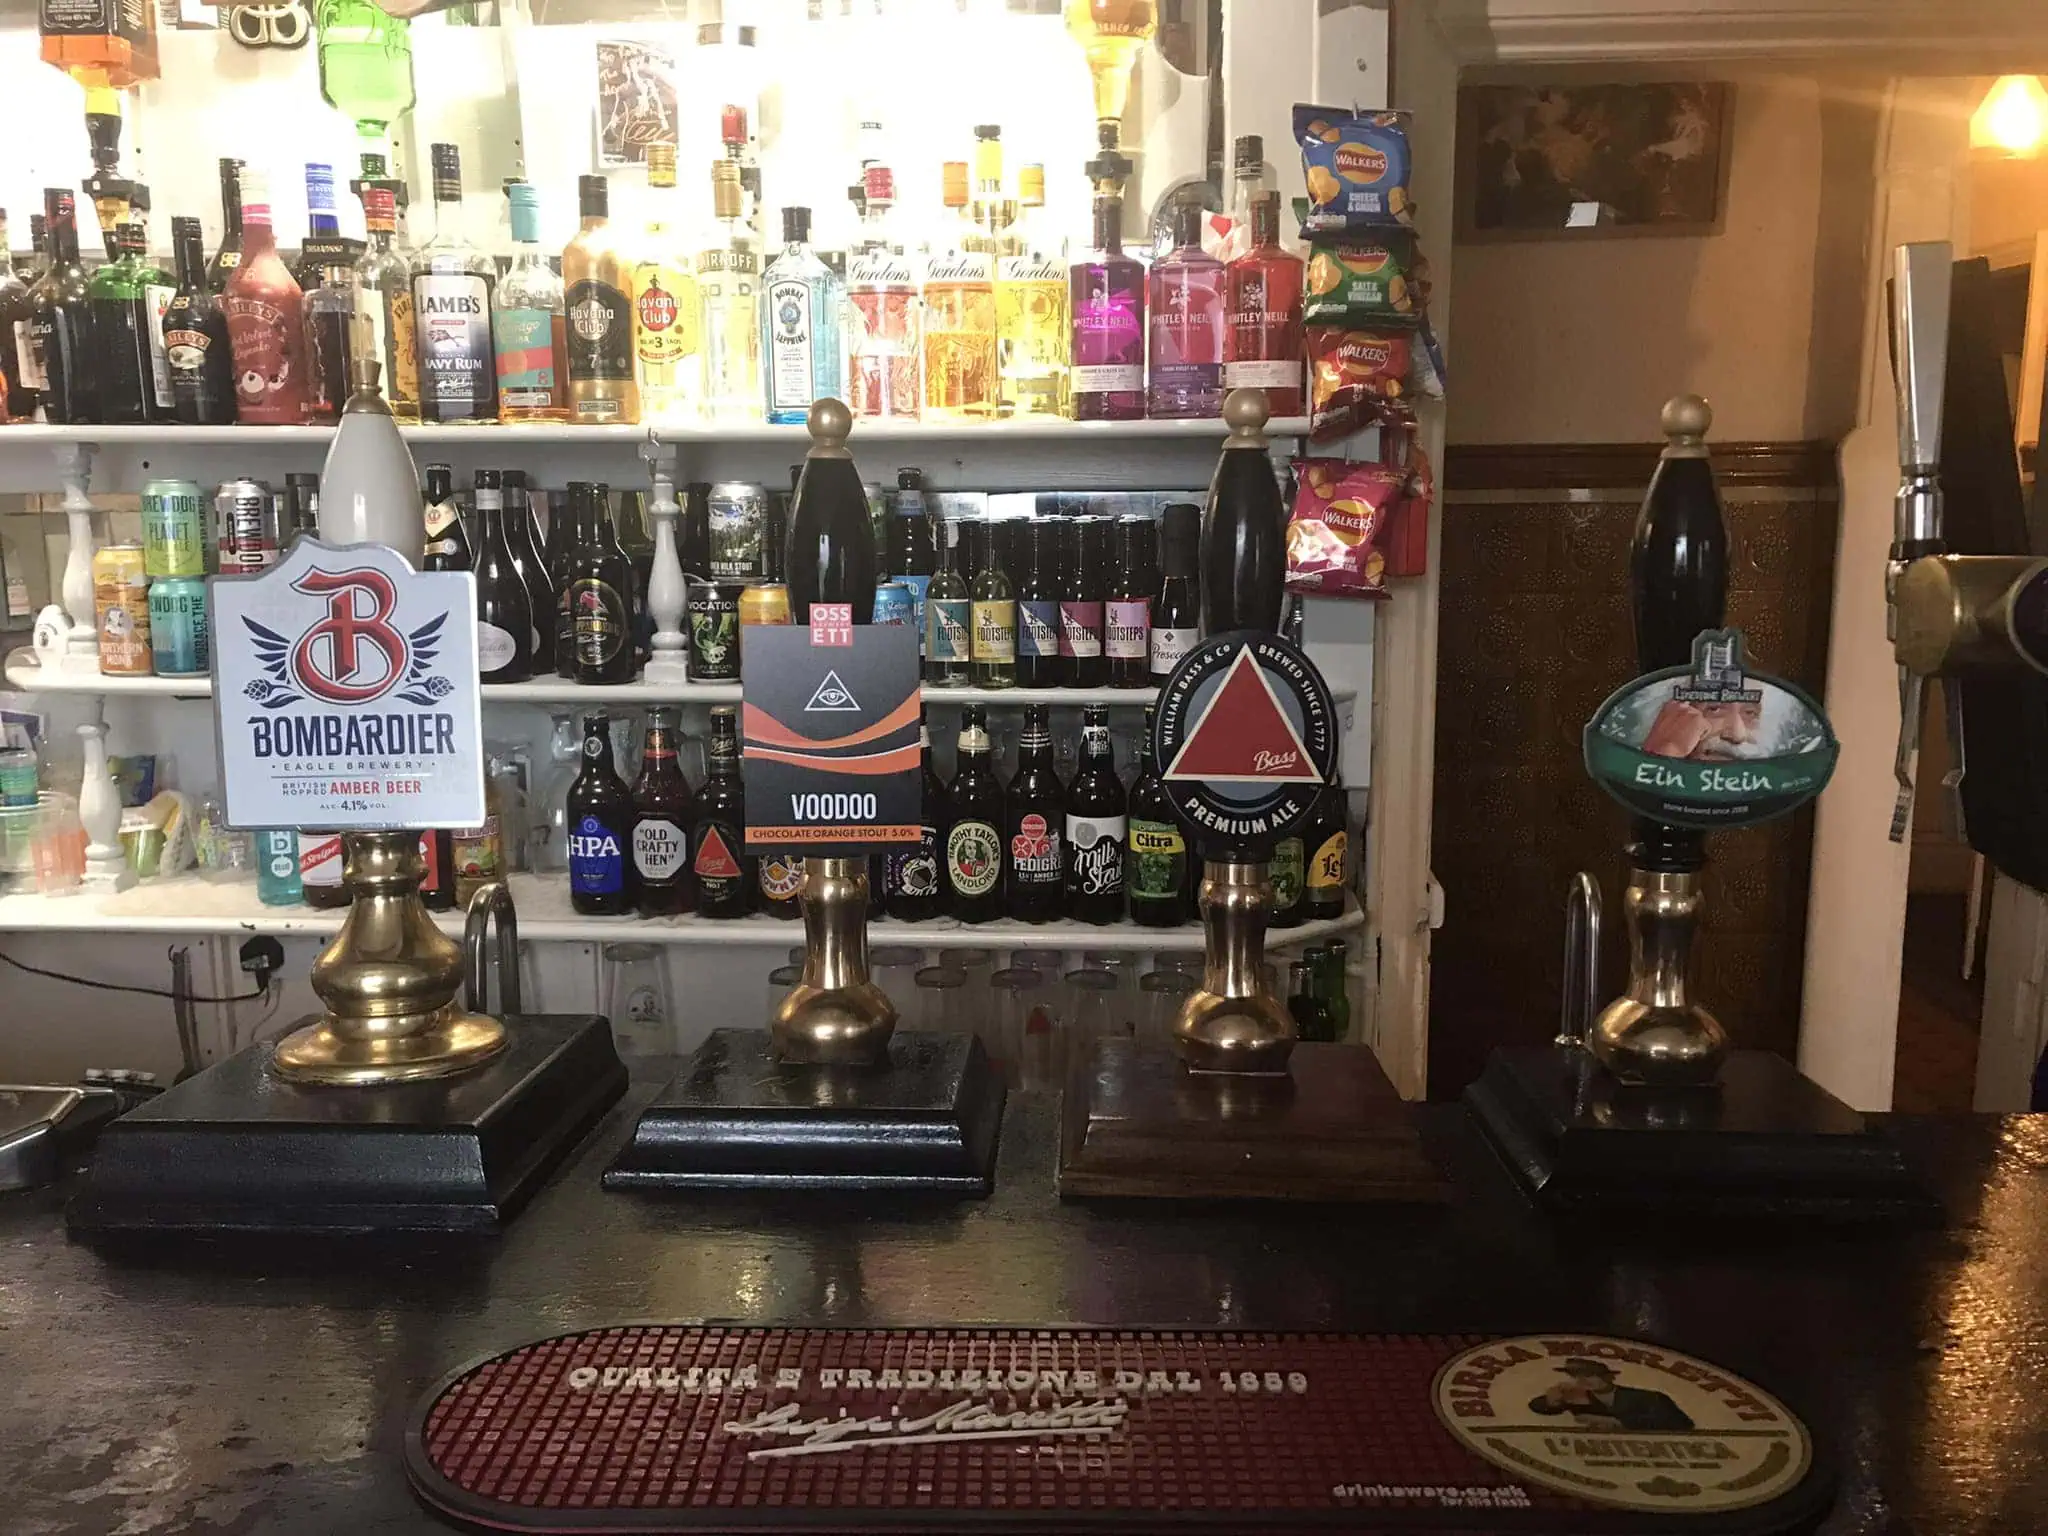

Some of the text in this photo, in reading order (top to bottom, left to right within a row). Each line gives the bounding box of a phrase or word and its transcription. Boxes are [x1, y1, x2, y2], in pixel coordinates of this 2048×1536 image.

[1336, 153, 1386, 169] WALKERS
[927, 259, 985, 279] Gordon's
[230, 303, 273, 319] AILEYS
[420, 295, 480, 314] LAMB'S
[570, 306, 614, 320] Havana
[643, 309, 671, 324] Club
[1152, 314, 1186, 325] WHITLEY
[1228, 311, 1289, 323] WHITLEY NEILL
[578, 320, 604, 333] Club
[168, 331, 206, 346] AILEYS
[1339, 343, 1388, 362] WALKERS
[424, 358, 482, 370] NAVY RUM
[1324, 510, 1374, 530] WALKERS
[152, 596, 188, 613] EWDOG
[1151, 642, 1185, 660] Prosecc
[1163, 694, 1183, 746] WILLIAM
[1179, 664, 1202, 690] BASS
[1204, 653, 1214, 665] &
[1259, 644, 1325, 751] BREWED SINCE 1777
[247, 713, 455, 758] BOMBARDIER
[284, 761, 423, 771] EAGLE BREWERY
[1254, 750, 1297, 772] Bass
[1635, 763, 1685, 788] Ein
[1700, 768, 1773, 792] Stein
[330, 780, 422, 795] AMBER BEER
[340, 800, 368, 811] 4.1%
[791, 793, 877, 820] VOODOO
[1185, 798, 1301, 835] PREMIUM ALE
[753, 828, 812, 839] CHOCOLATE
[813, 828, 857, 838] ORANGE
[858, 828, 887, 838] STOUT
[1136, 834, 1173, 848] Citra
[569, 834, 620, 858] HPA
[636, 840, 679, 853] CRAFTY
[1074, 841, 1115, 876] Milk
[952, 867, 995, 888] LANDLORD
[775, 1367, 801, 1390] E
[820, 1367, 1098, 1393] TRADIZIONE
[1115, 1370, 1201, 1394] DAL
[1219, 1370, 1308, 1394] 1859
[1451, 1340, 1780, 1423] BIRRA MORETTI
